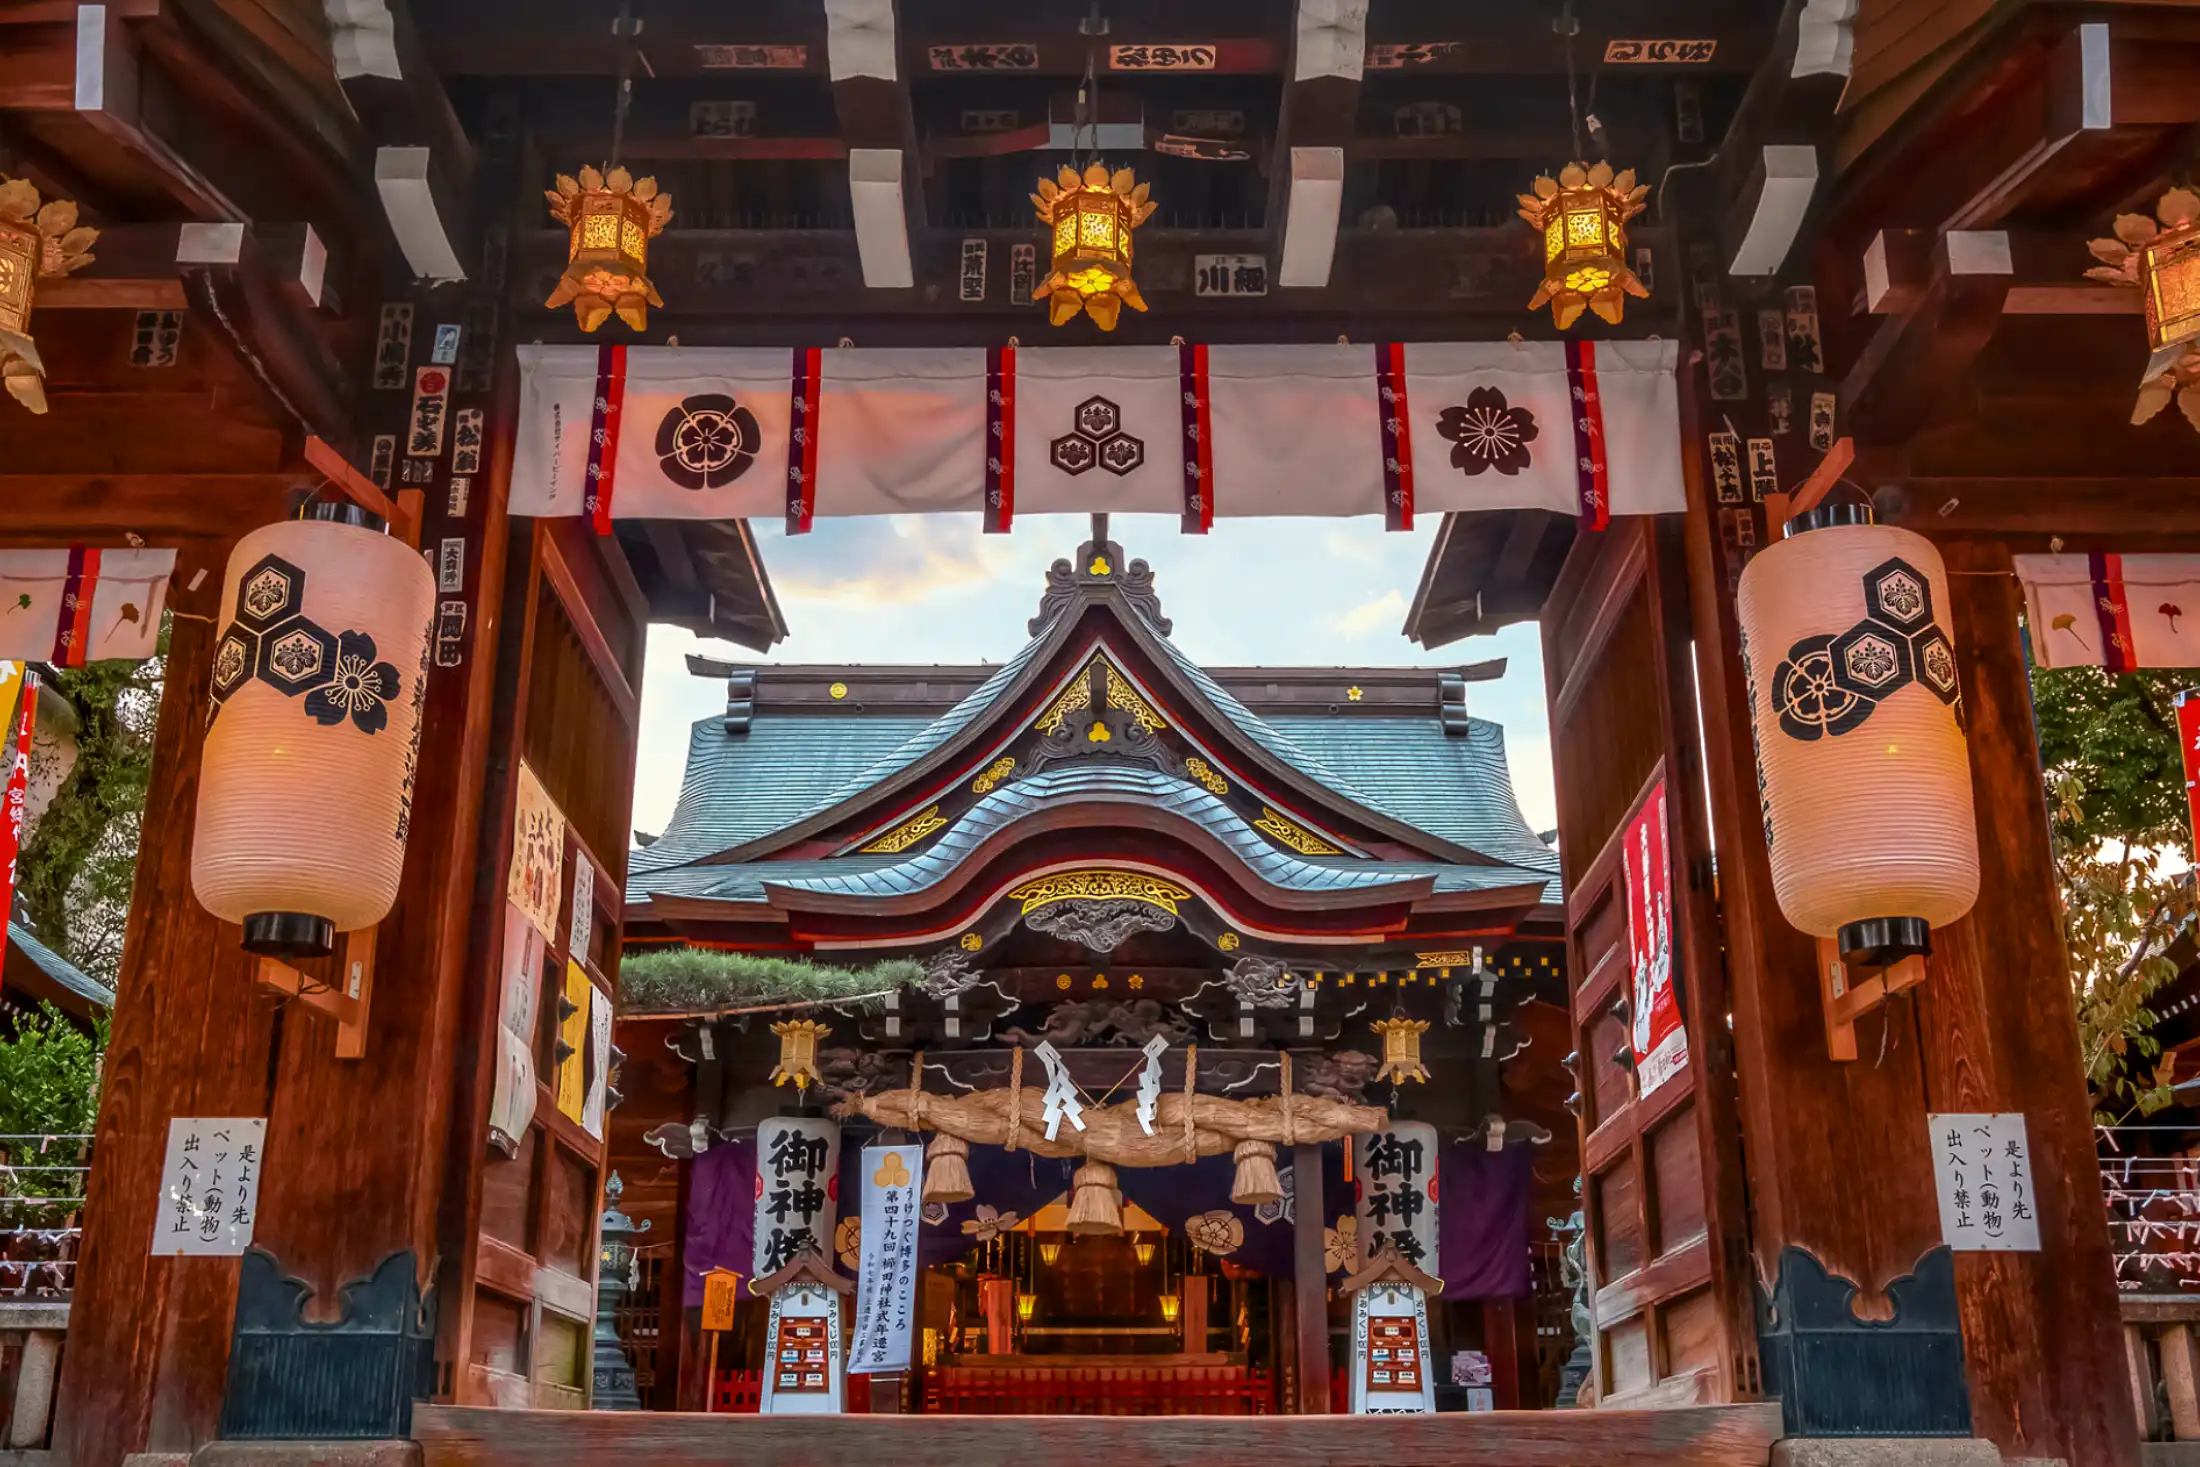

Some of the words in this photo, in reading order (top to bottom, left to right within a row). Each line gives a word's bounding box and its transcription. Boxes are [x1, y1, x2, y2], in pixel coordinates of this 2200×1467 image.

[171, 1133, 200, 1234] 出入り禁止
[230, 1144, 256, 1225] 是より先
[1947, 1129, 1975, 1229] 出入り禁止
[2004, 1140, 2032, 1220] 是より先
[895, 1187, 914, 1331] うけつぐ博多のこころ
